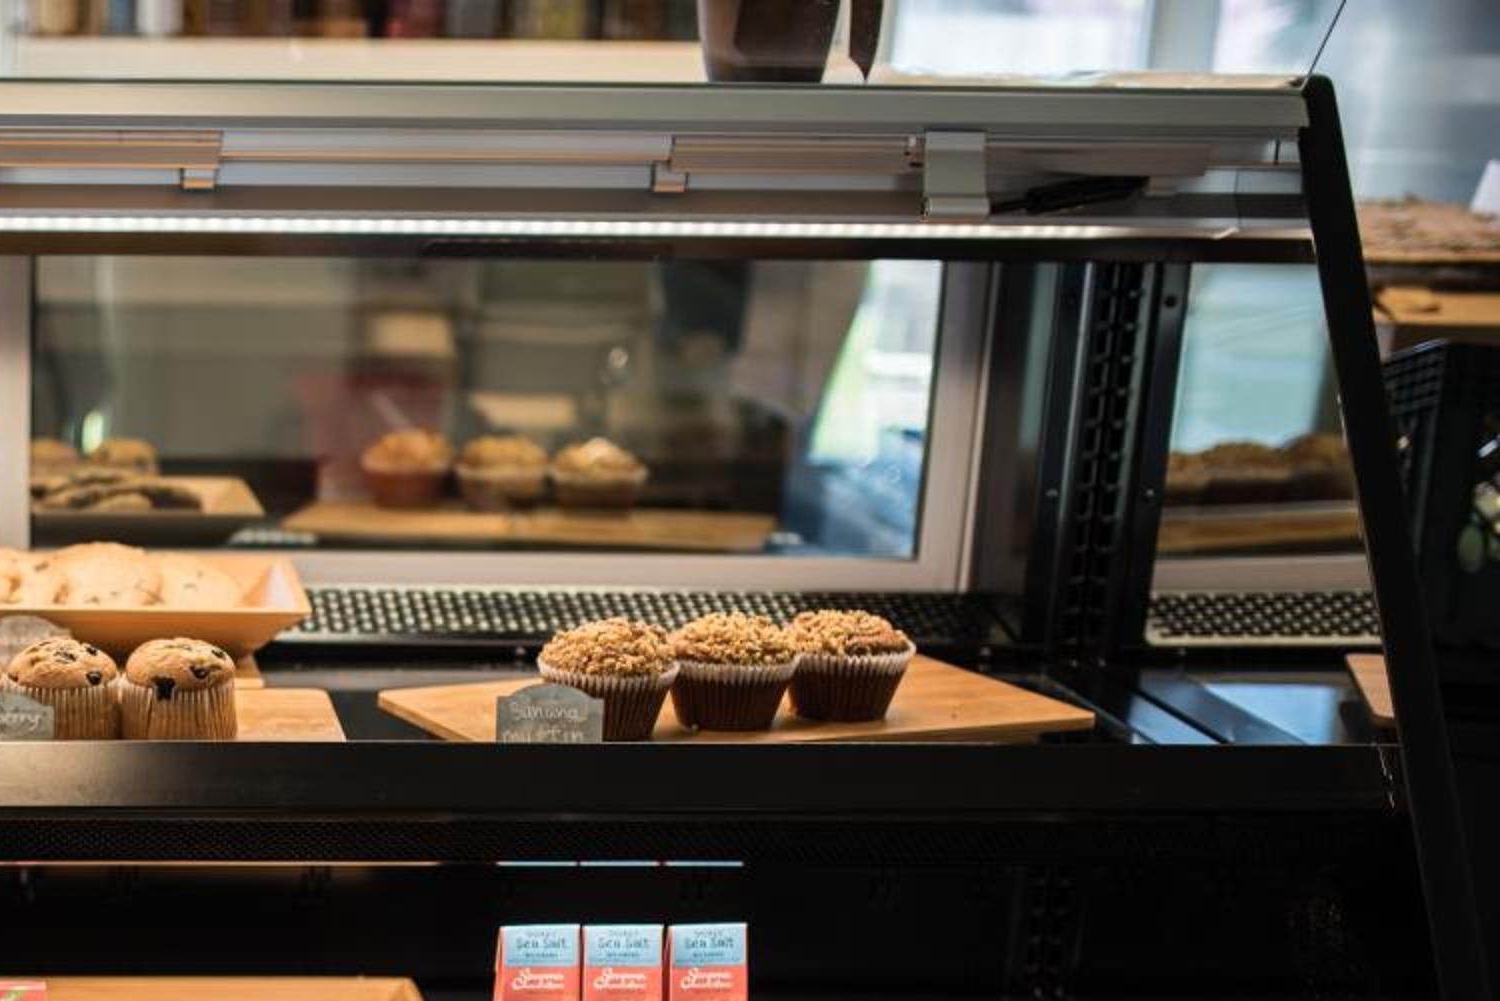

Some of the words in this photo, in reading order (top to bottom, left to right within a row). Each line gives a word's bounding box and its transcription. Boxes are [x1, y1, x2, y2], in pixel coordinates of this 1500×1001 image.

[515, 937, 539, 949] Sea
[543, 936, 567, 949] Salt
[597, 937, 622, 949] Sea
[626, 936, 650, 949] Salt
[683, 937, 707, 949] Sea
[710, 936, 735, 949] Salt
